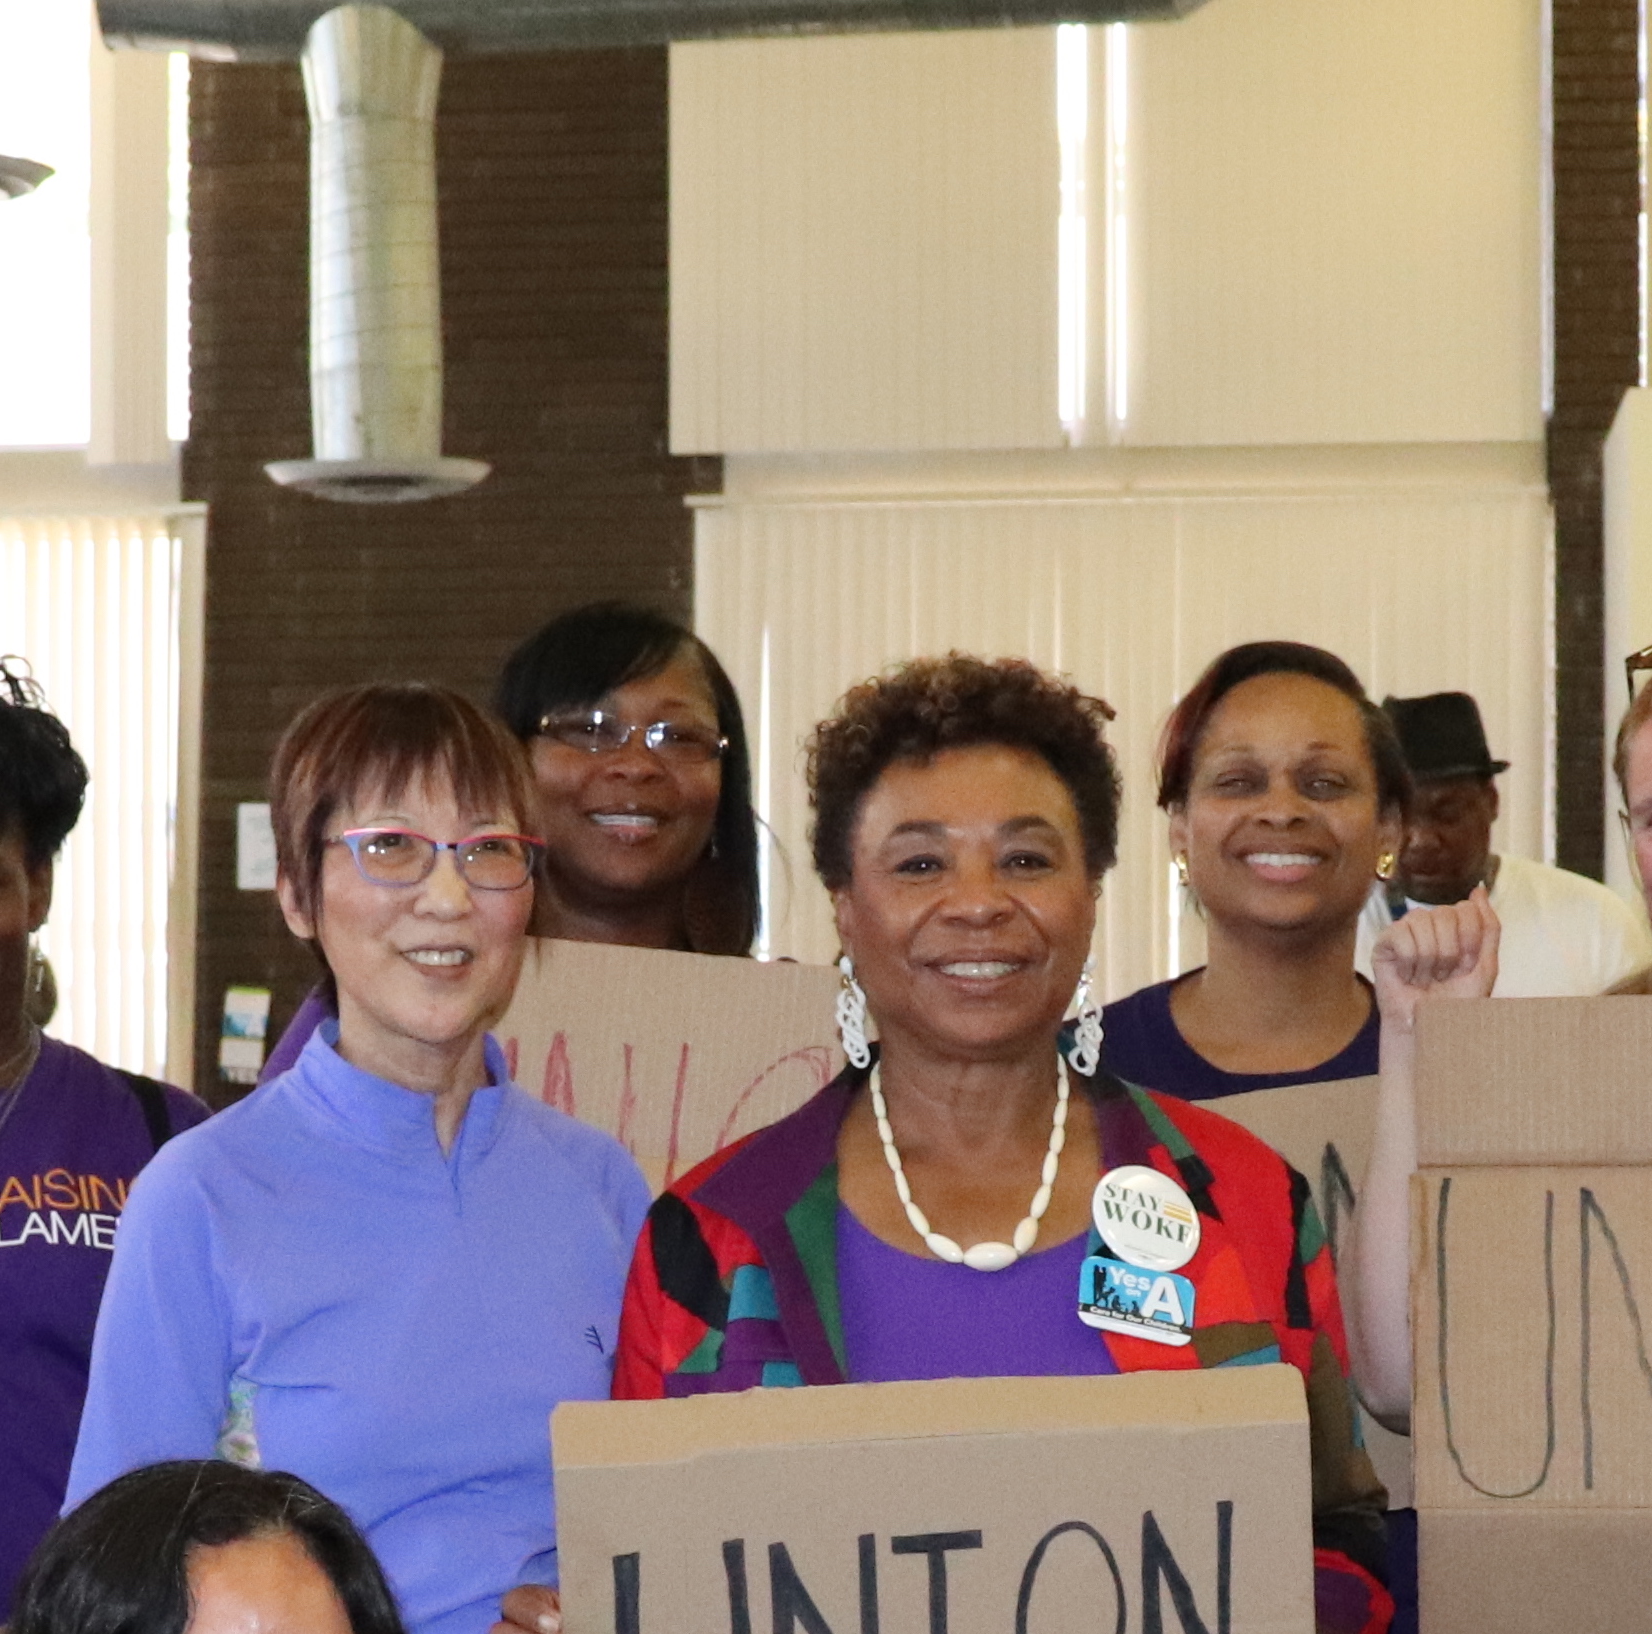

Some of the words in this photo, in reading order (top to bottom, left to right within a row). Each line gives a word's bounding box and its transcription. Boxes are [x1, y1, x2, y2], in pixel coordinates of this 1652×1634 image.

[1104, 1183, 1162, 1212] STAY
[1109, 1265, 1151, 1292] Yes
[1125, 1287, 1143, 1299] on
[1141, 1275, 1187, 1326] A
